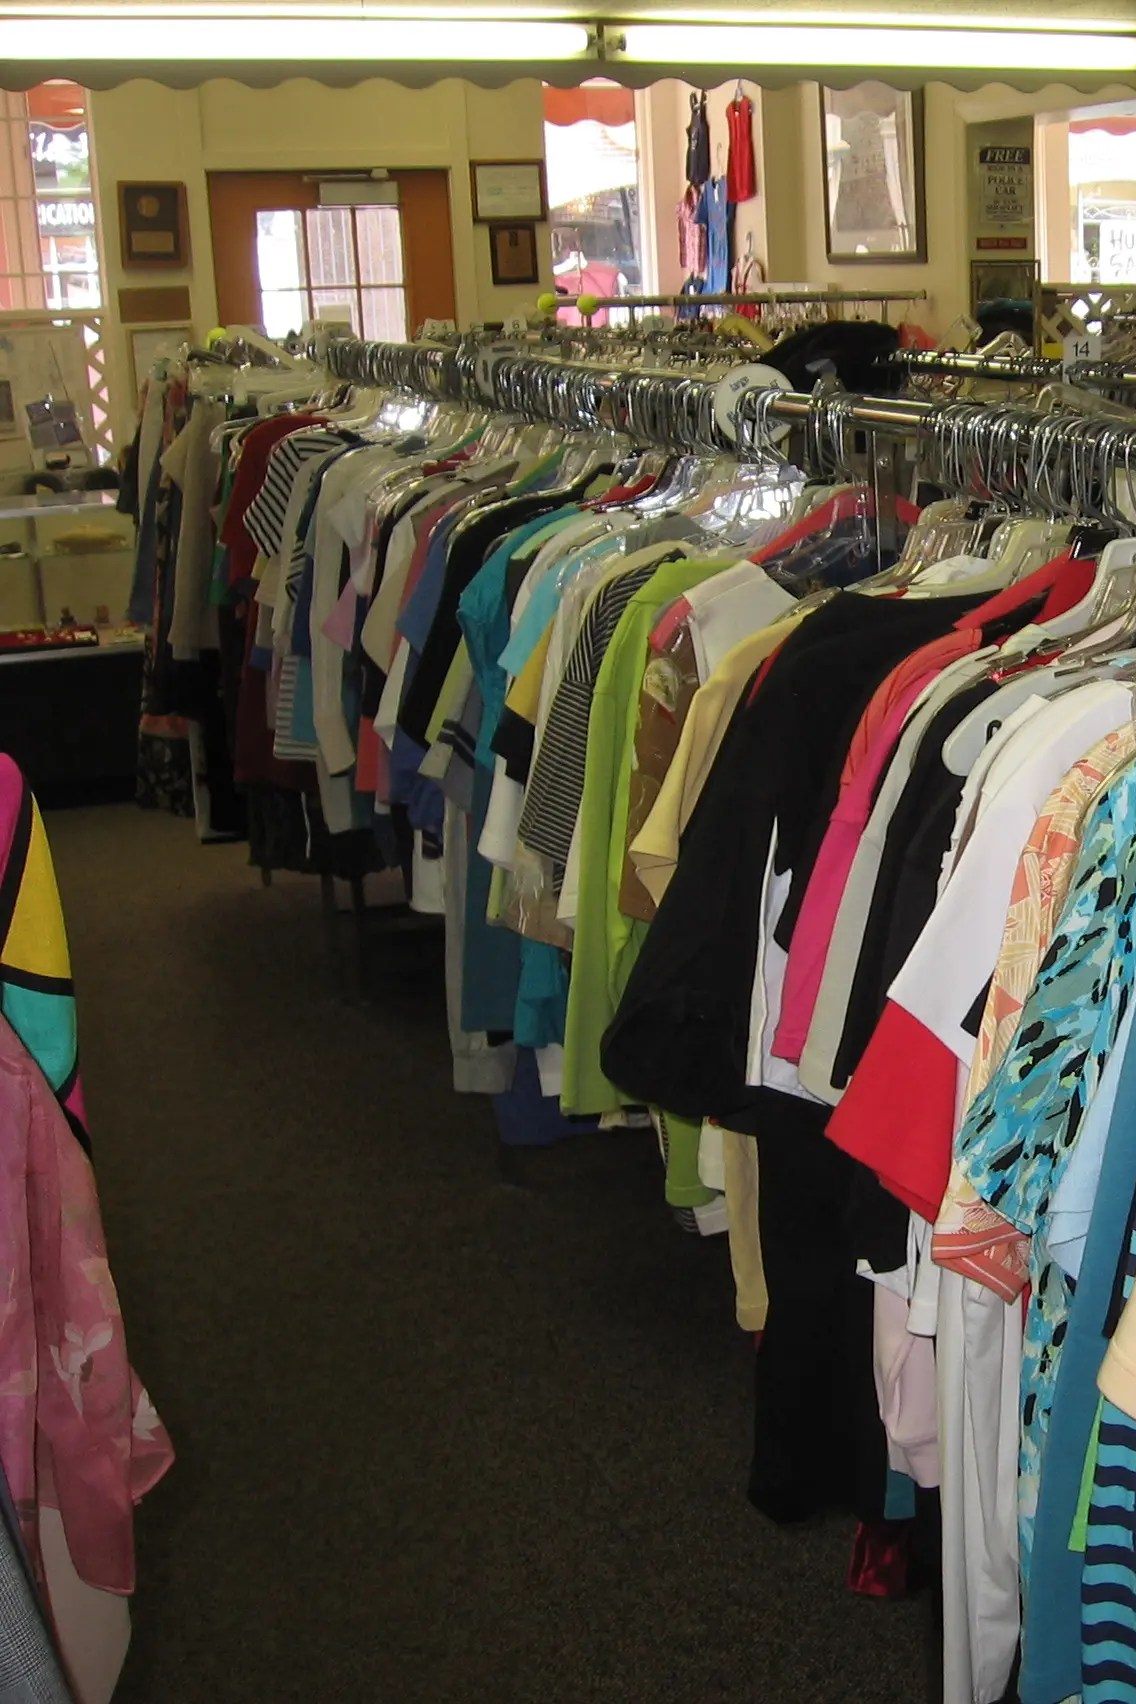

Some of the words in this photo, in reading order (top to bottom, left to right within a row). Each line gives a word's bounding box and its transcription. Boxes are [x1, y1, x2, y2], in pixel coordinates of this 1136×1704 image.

[985, 149, 1025, 162] FREE
[987, 175, 1024, 186] POLICE
[995, 186, 1017, 196] CAR
[1073, 341, 1090, 358] 14
